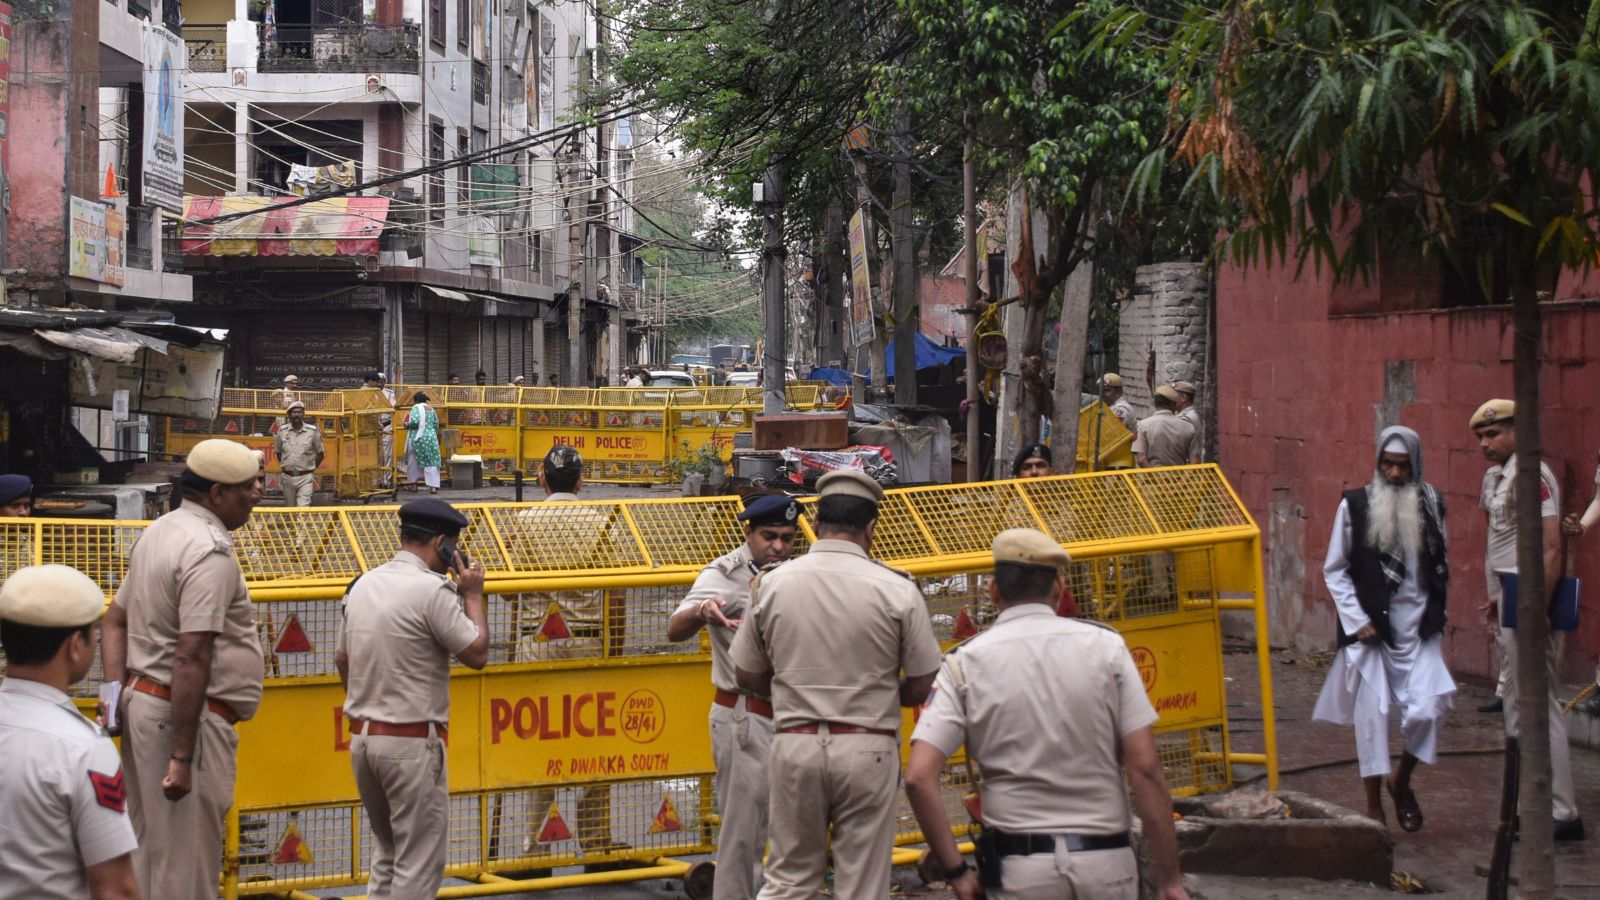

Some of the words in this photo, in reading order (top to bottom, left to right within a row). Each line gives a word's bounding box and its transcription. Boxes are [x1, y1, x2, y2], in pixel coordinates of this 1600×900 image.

[596, 436, 631, 449] POLICE
[629, 697, 654, 709] DWD
[1155, 691, 1197, 712] DWARKA
[491, 692, 616, 745] POLICE
[625, 712, 656, 737] 28/41
[571, 755, 626, 776] DWARKA
[631, 753, 669, 772] SOUTH
